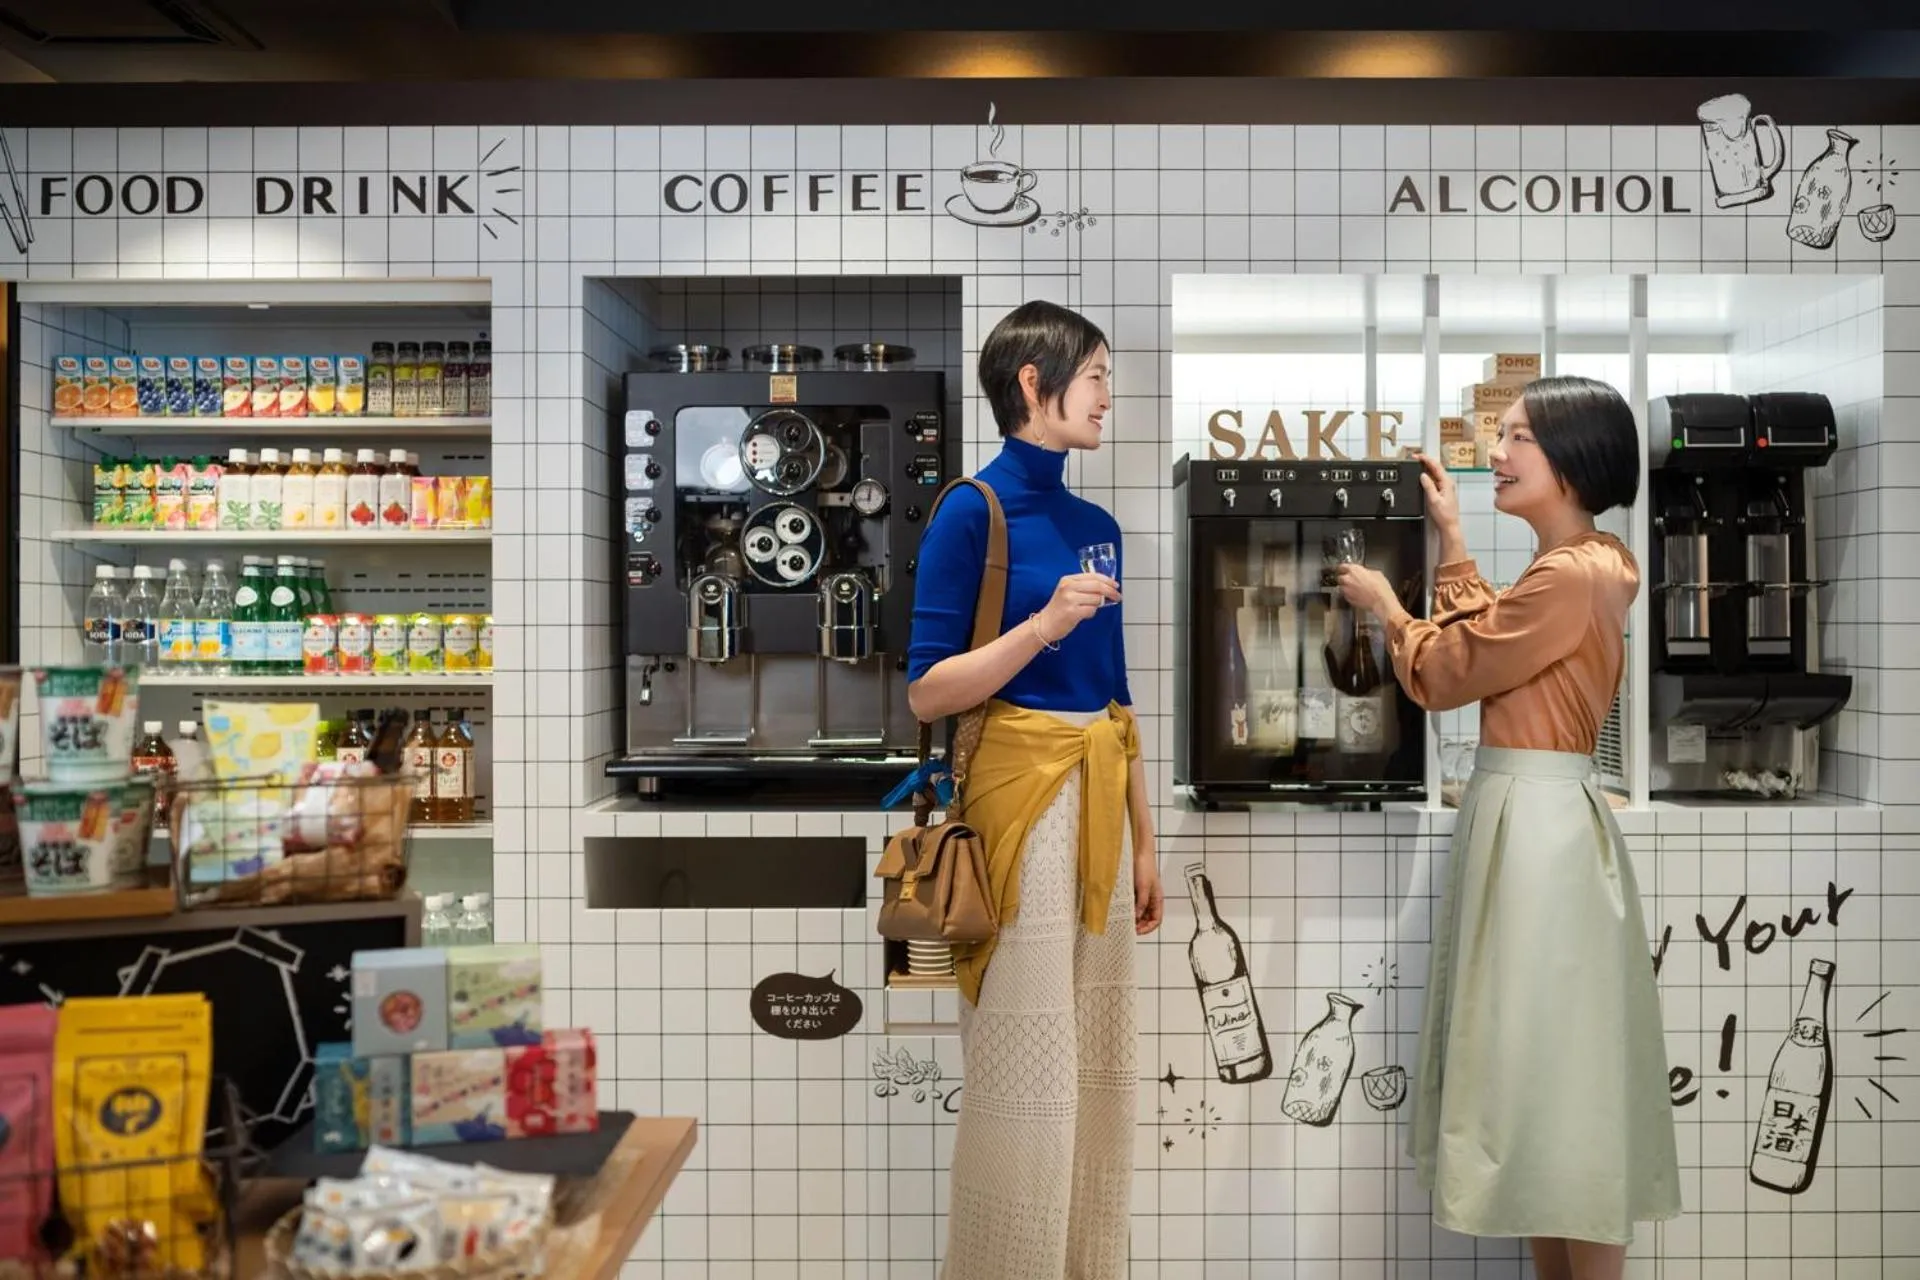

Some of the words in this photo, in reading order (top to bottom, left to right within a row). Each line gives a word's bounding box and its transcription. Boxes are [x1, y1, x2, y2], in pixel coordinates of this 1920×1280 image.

[40, 174, 205, 216] FOOD
[256, 174, 475, 216] DRINK
[663, 173, 928, 214] COFFEE
[1388, 174, 1692, 214] ALCOHOL
[1504, 357, 1535, 367] OMO
[1482, 387, 1513, 398] OMO
[1207, 409, 1404, 461] SAKE
[1695, 881, 1855, 971] Your
[767, 992, 841, 1003] コーヒーカップは
[785, 1018, 822, 1029] ください
[1762, 1099, 1812, 1154] 日本酒
